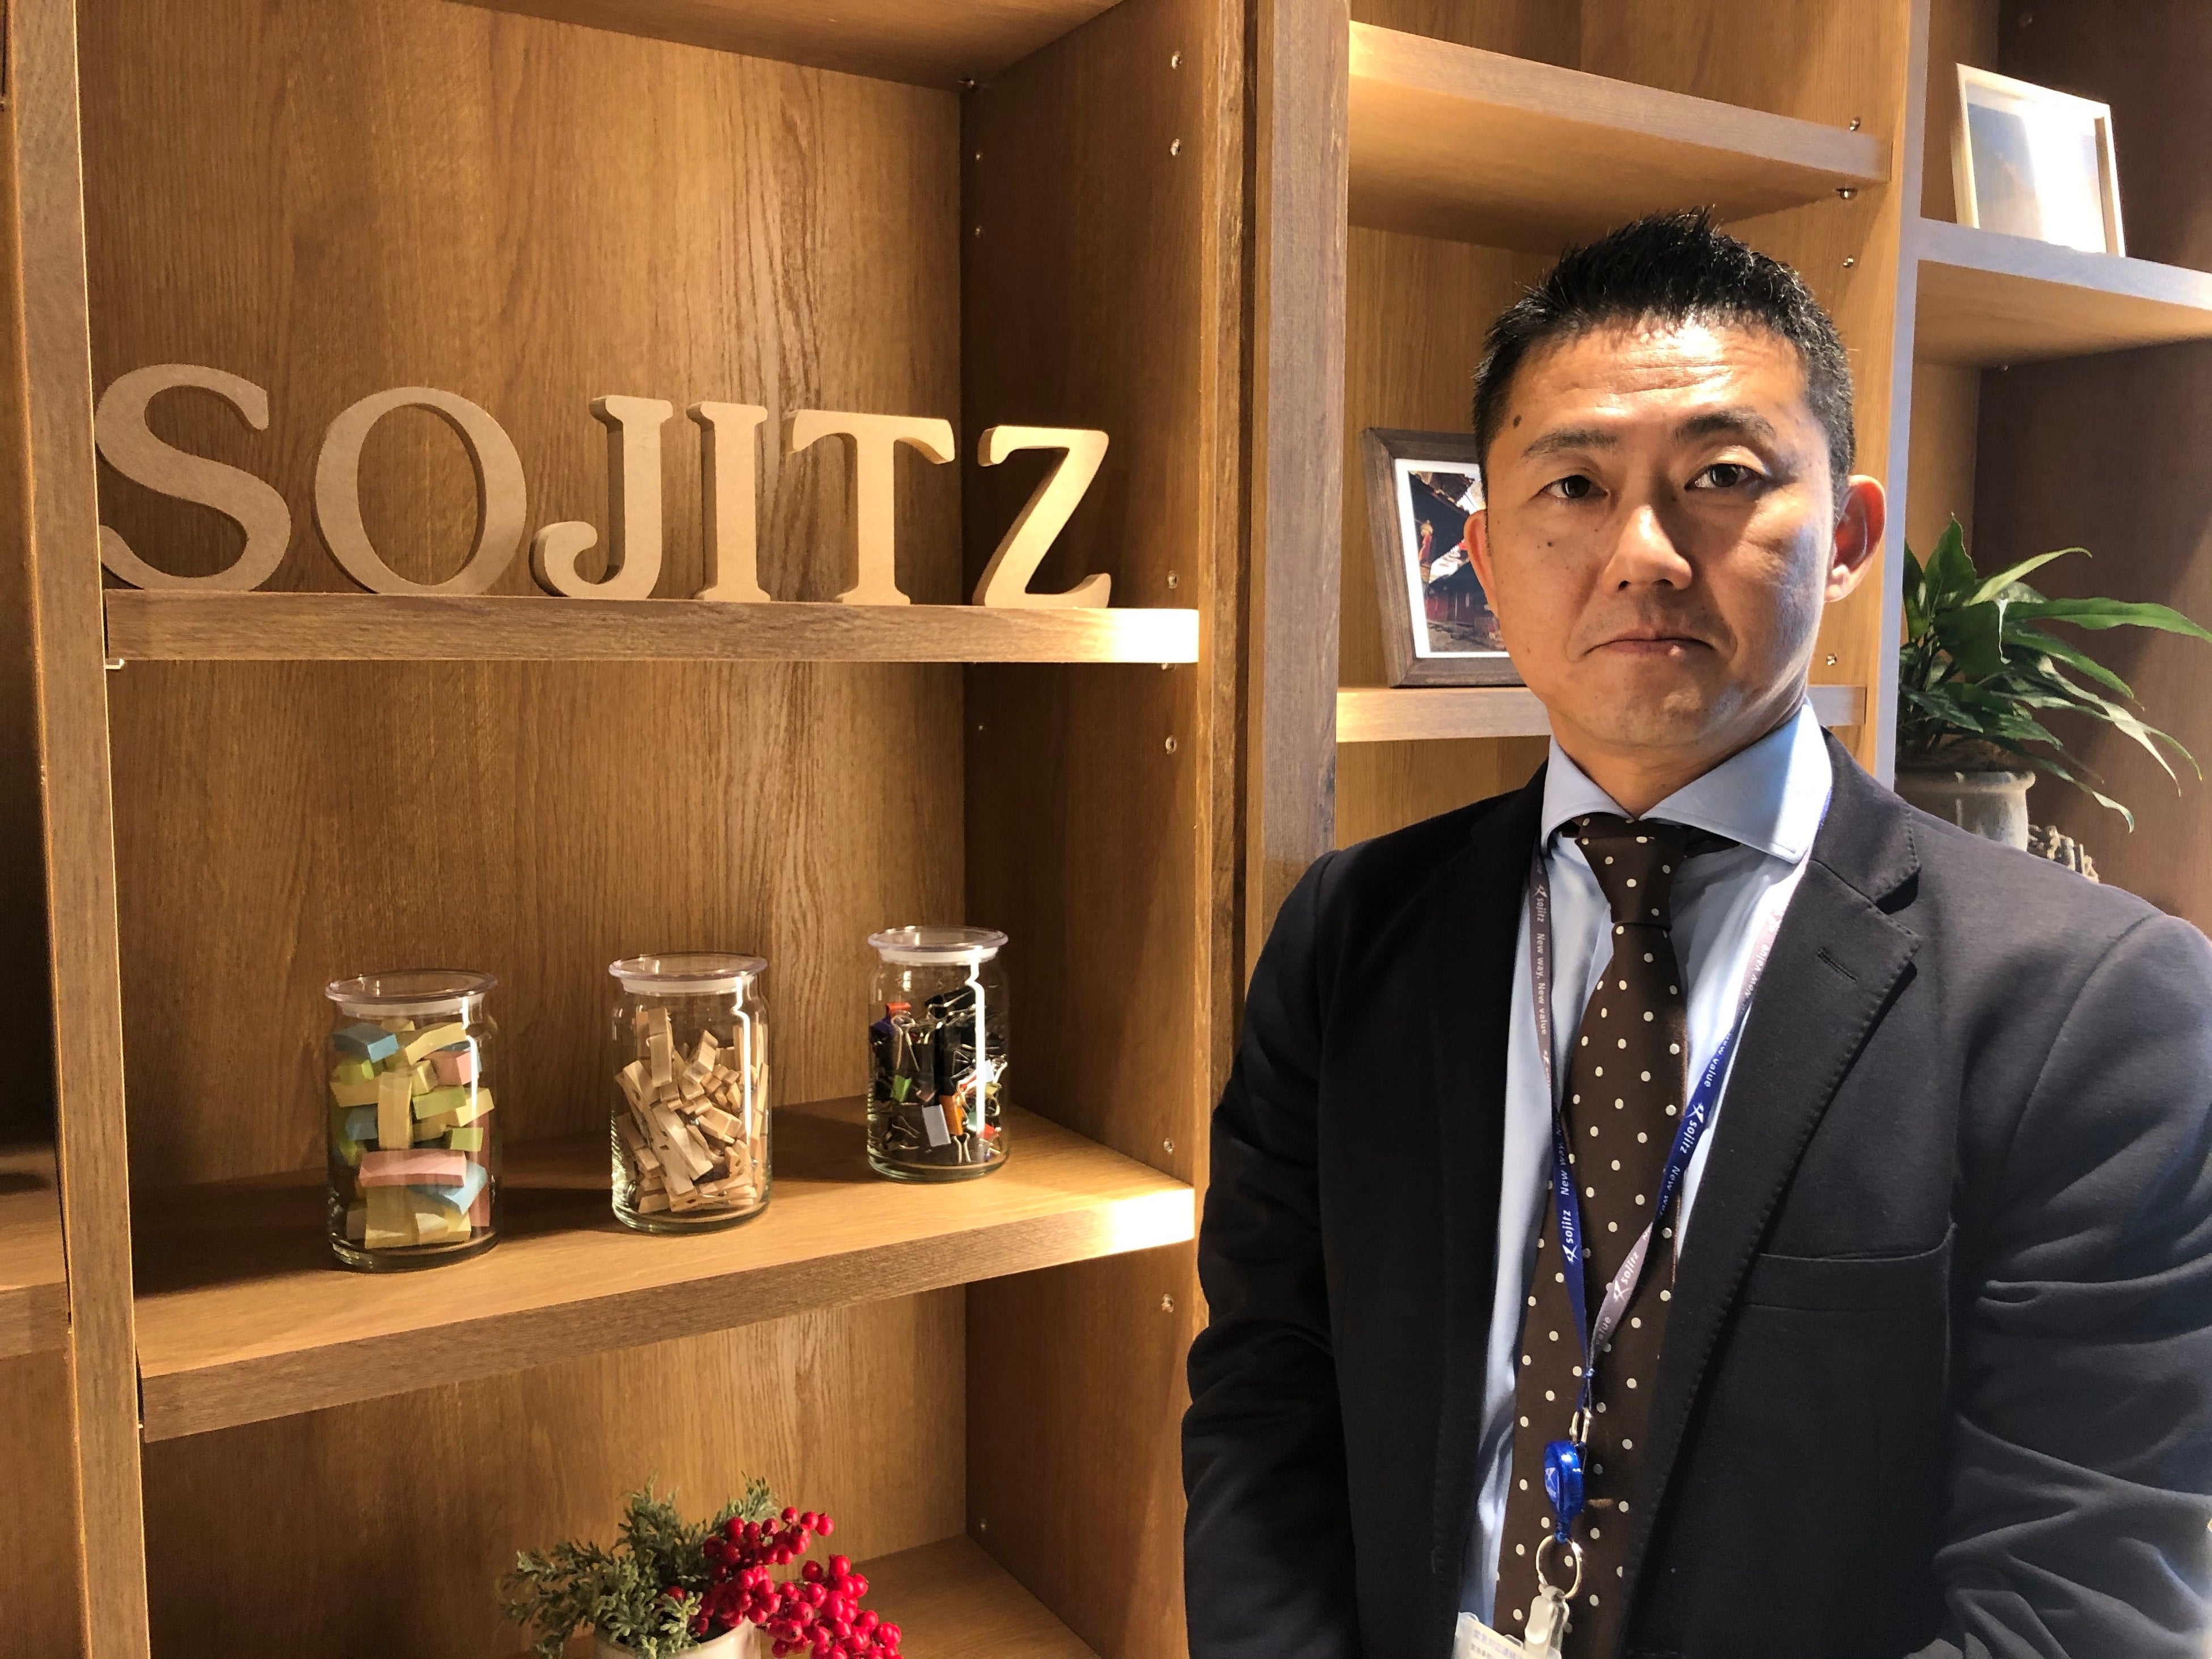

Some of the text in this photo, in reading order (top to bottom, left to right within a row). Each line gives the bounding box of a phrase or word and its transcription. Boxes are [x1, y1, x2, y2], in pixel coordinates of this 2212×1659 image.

[95, 364, 1111, 609] SOJITZ
[1536, 898, 1547, 922] sojitz
[1536, 933, 1546, 954] New
[1744, 944, 1770, 998] New value
[1538, 982, 1546, 1004] New
[1539, 1007, 1548, 1035] value
[1704, 1058, 1719, 1088] value
[1679, 1120, 1698, 1154] sojitz
[1560, 1170, 1569, 1196] New
[1666, 1165, 1681, 1191] New
[1561, 1209, 1576, 1244] sojitz
[1621, 1251, 1639, 1285] sojitz
